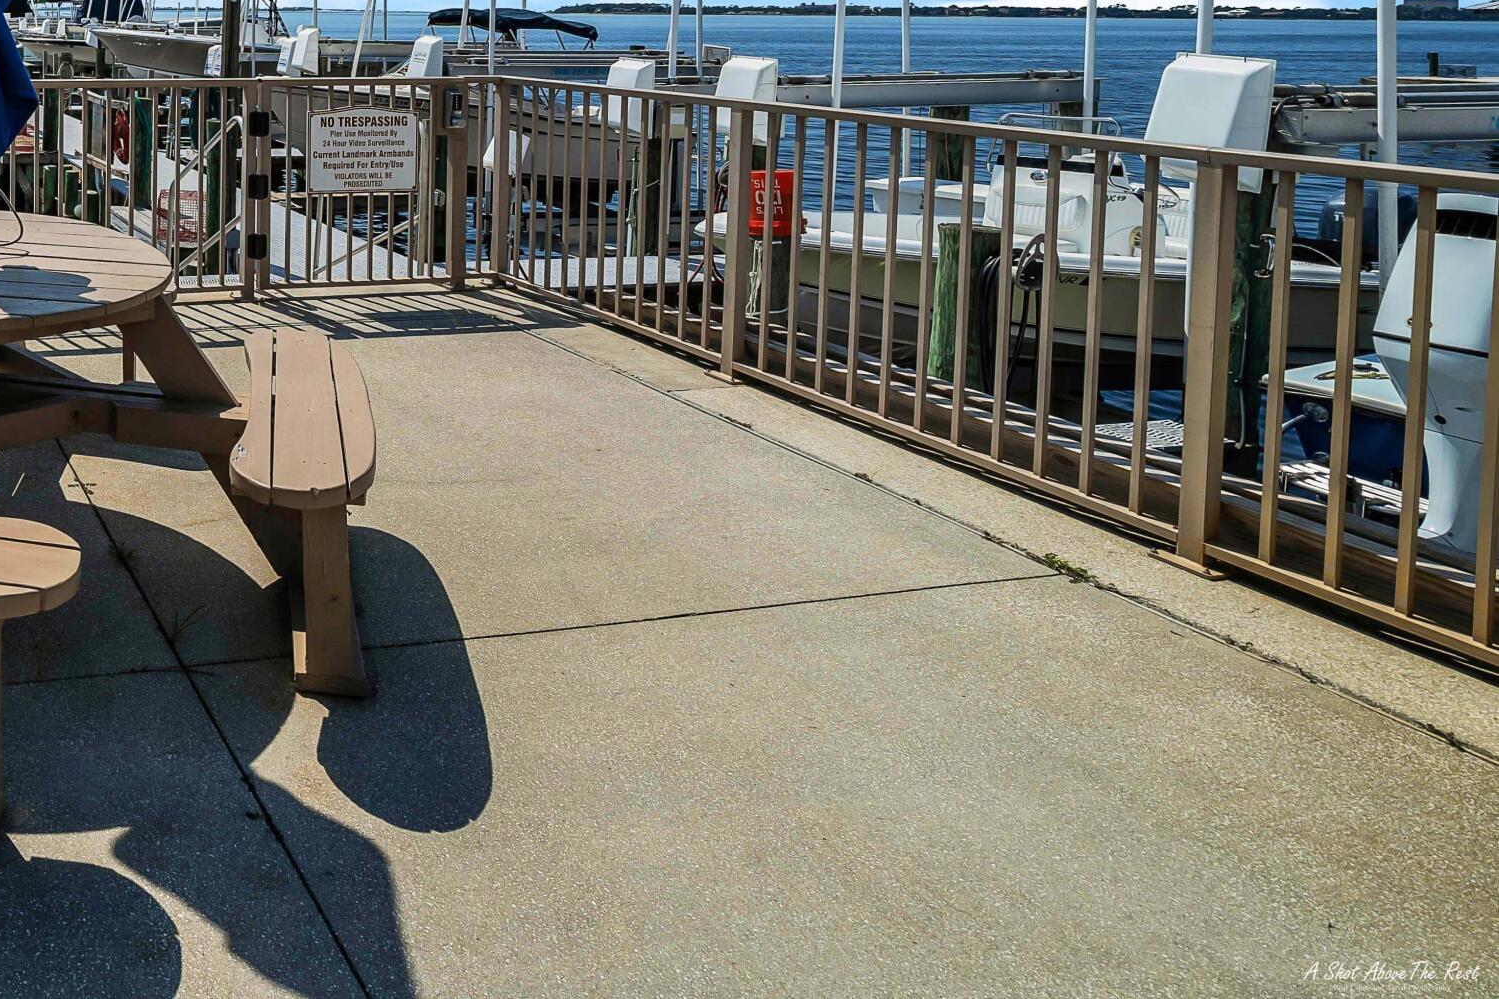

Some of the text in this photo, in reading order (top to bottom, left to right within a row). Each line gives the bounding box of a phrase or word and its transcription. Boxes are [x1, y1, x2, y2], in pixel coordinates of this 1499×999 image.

[320, 116, 408, 128] NO TRESPASSING
[330, 130, 342, 138] Pier
[357, 129, 388, 137] Monitored
[390, 130, 398, 138] By
[348, 139, 366, 147] Video
[367, 139, 405, 147] Surveillance
[312, 150, 414, 159] Current Landmark Armbands
[323, 160, 404, 171] Required For Entry/Use
[334, 172, 367, 180] VIOLATORS
[343, 180, 383, 188] PROSECUTED
